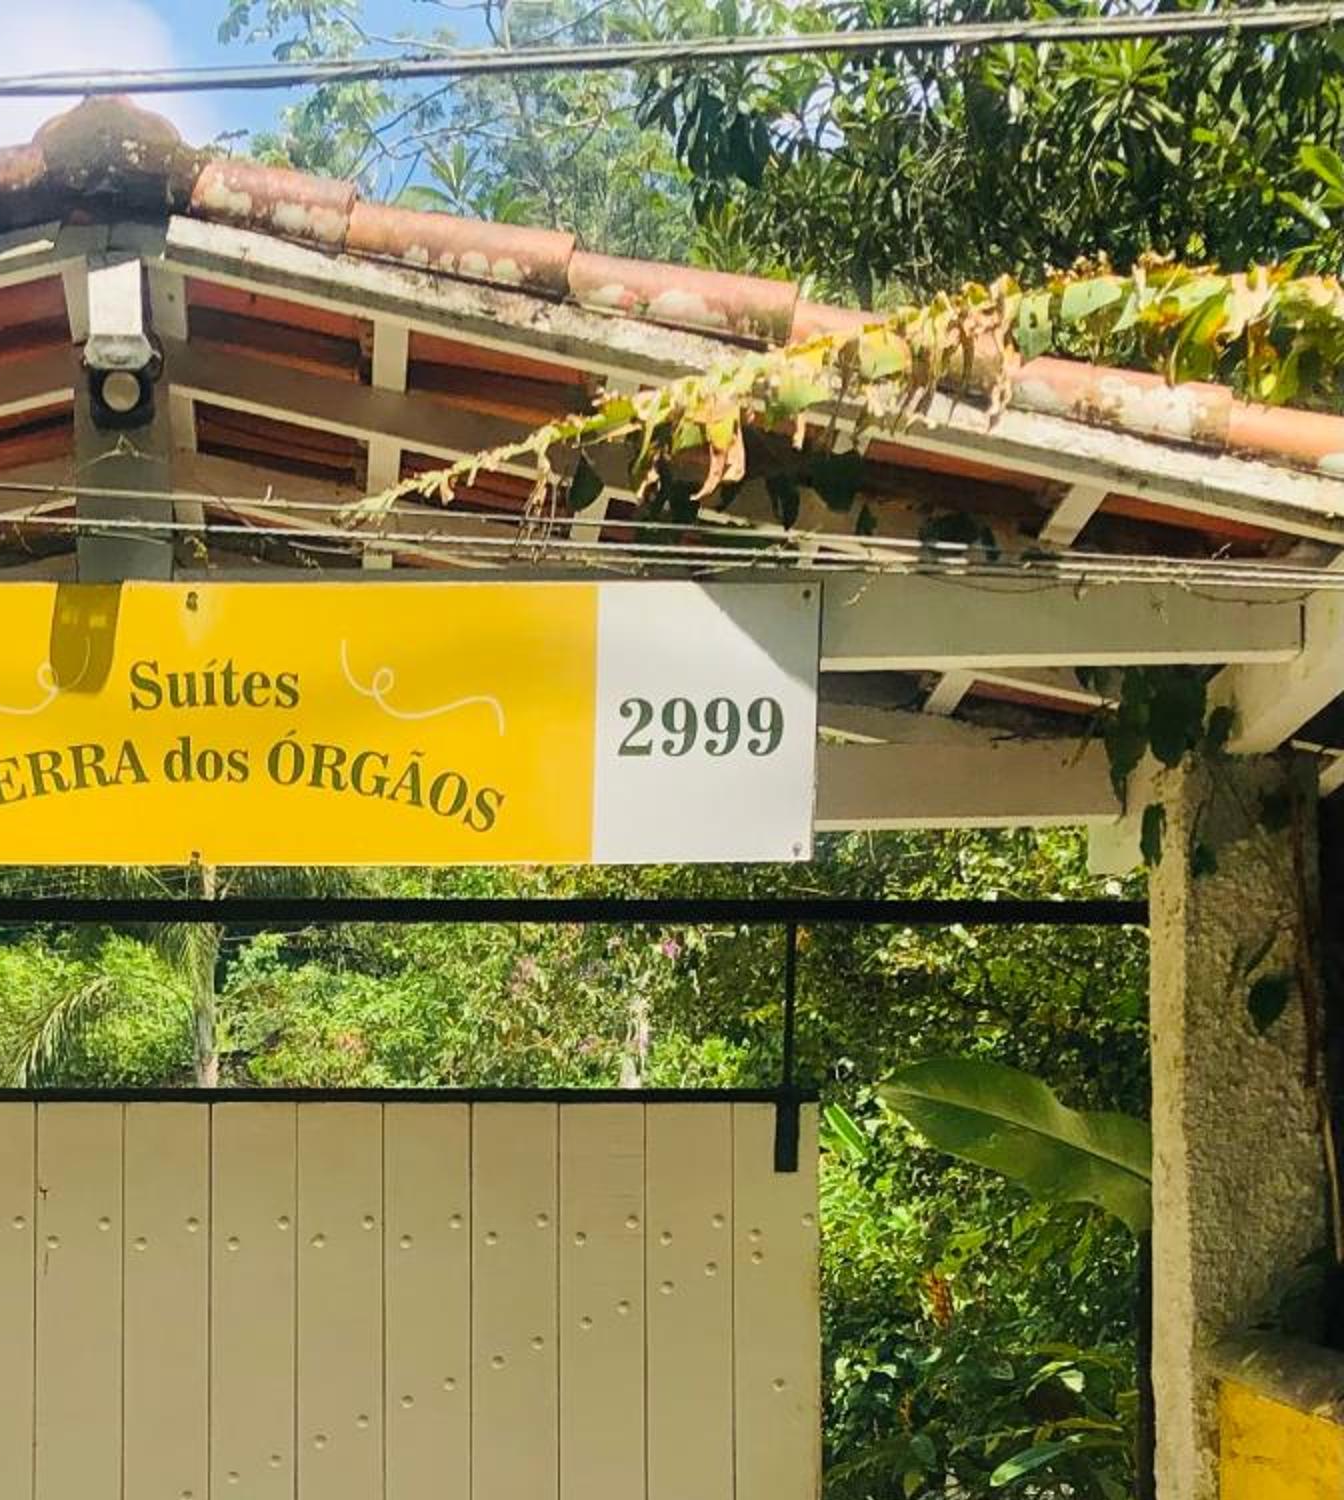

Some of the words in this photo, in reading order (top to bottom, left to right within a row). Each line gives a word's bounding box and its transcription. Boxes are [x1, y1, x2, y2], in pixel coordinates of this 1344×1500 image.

[129, 658, 300, 711] Suítes
[618, 697, 784, 756] 2999
[163, 735, 249, 782] dos
[267, 729, 505, 832] ÓRGÃOS
